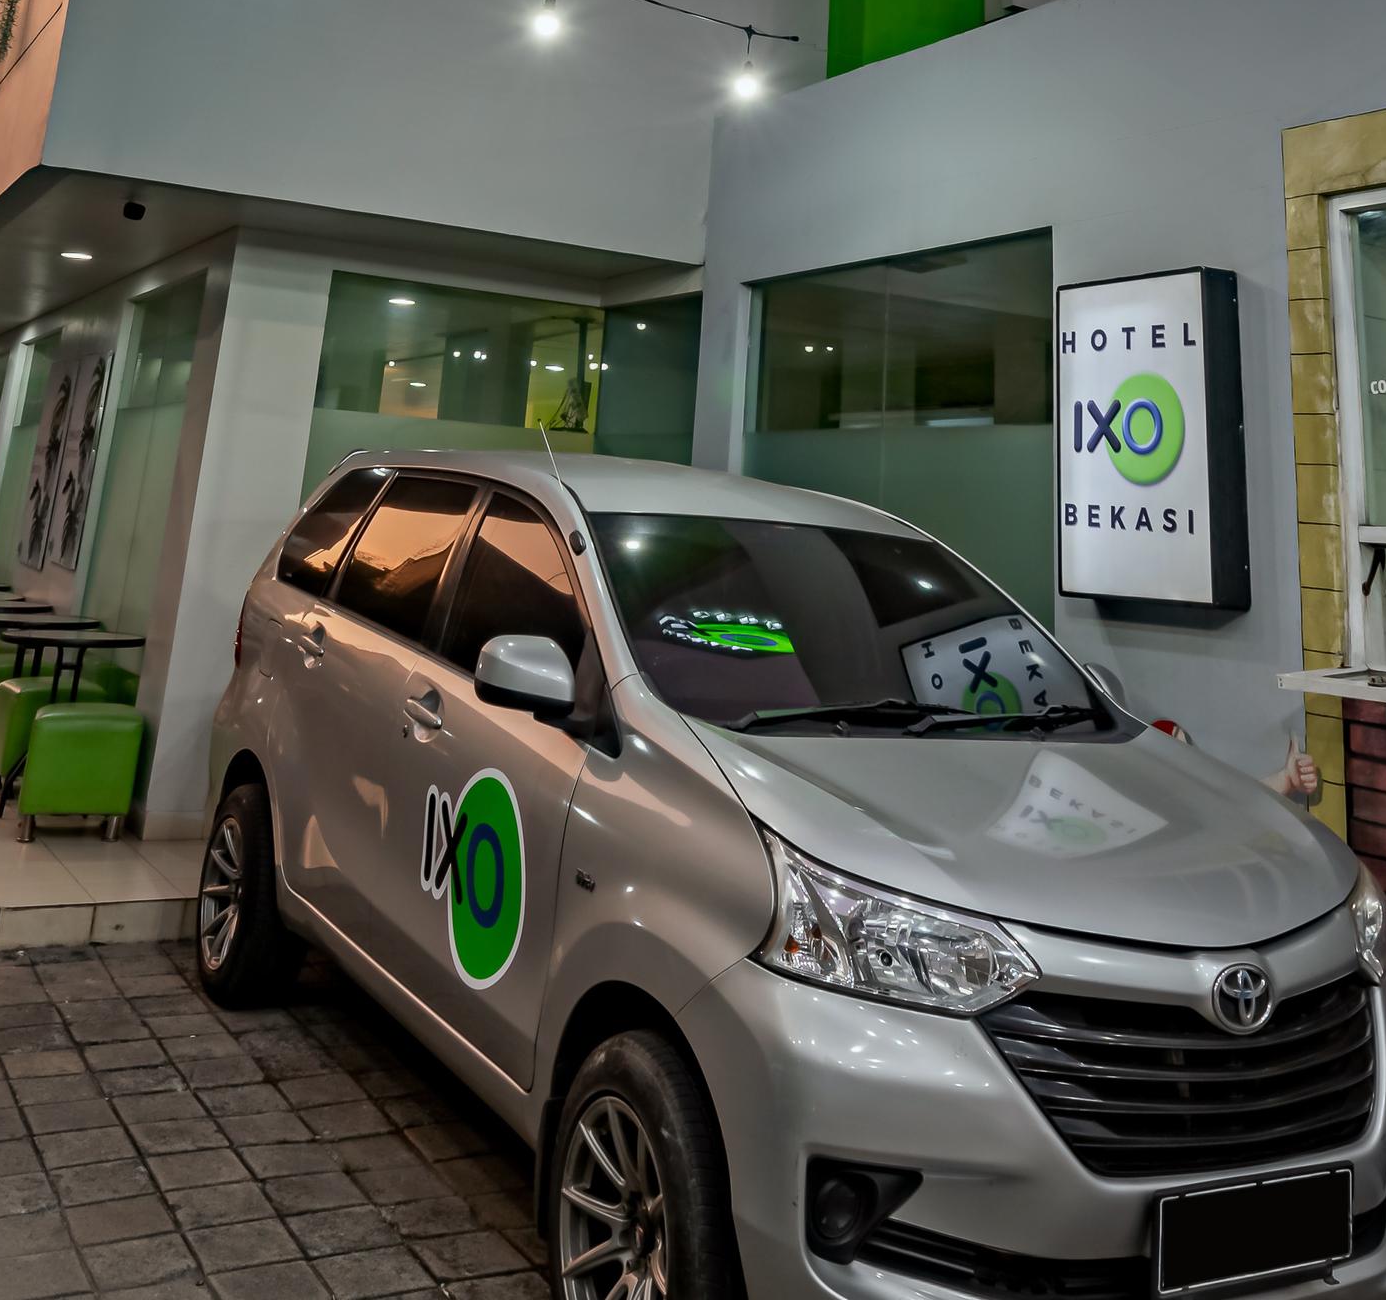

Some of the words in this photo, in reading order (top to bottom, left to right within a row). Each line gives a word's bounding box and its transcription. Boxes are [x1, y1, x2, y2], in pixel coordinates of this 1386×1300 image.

[1061, 322, 1197, 354] HOTEL
[1073, 398, 1164, 456] IXO
[1064, 503, 1196, 535] BEKASI
[421, 784, 505, 929] IXO
